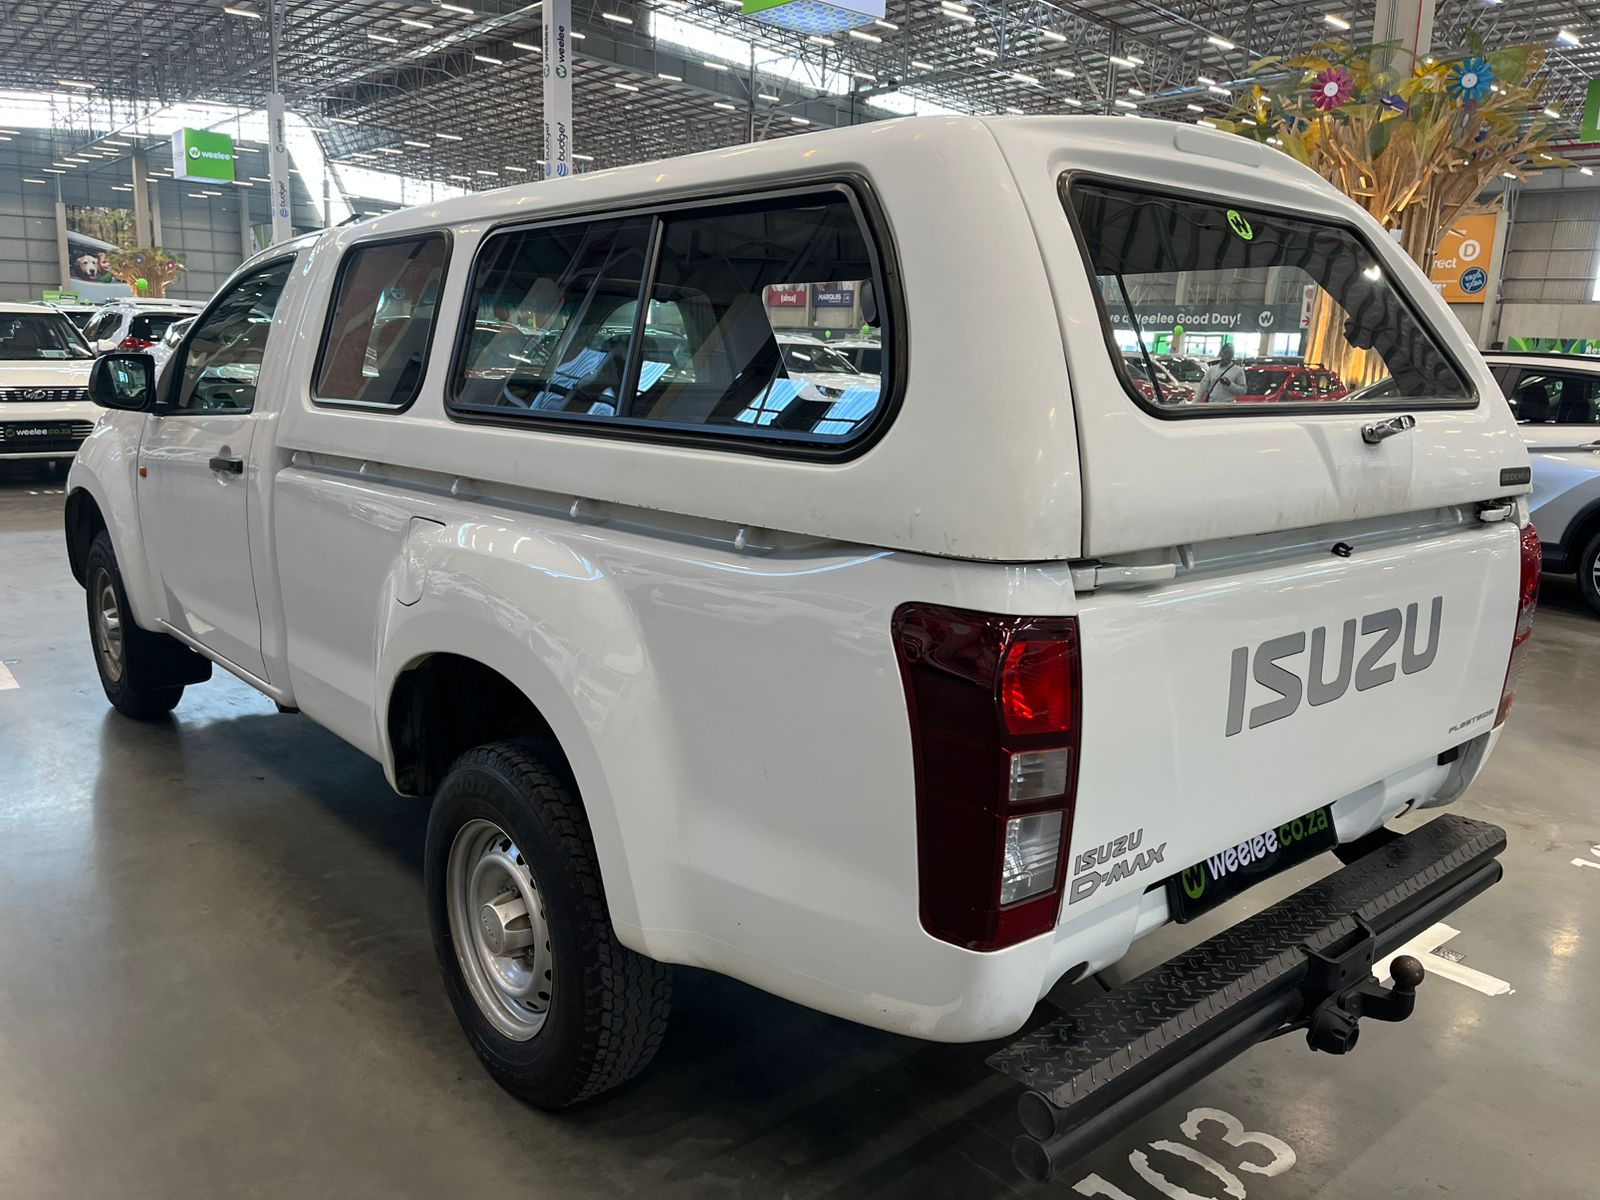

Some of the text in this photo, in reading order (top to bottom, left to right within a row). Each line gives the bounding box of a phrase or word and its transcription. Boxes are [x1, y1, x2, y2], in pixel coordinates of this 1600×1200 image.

[201, 151, 231, 161] weelee
[557, 121, 569, 162] budget
[1176, 313, 1210, 325] Good
[1211, 313, 1242, 326] Day!
[1225, 595, 1443, 738] ISUZU
[1068, 842, 1167, 906] D-MAX
[1074, 827, 1144, 876] ISUZU
